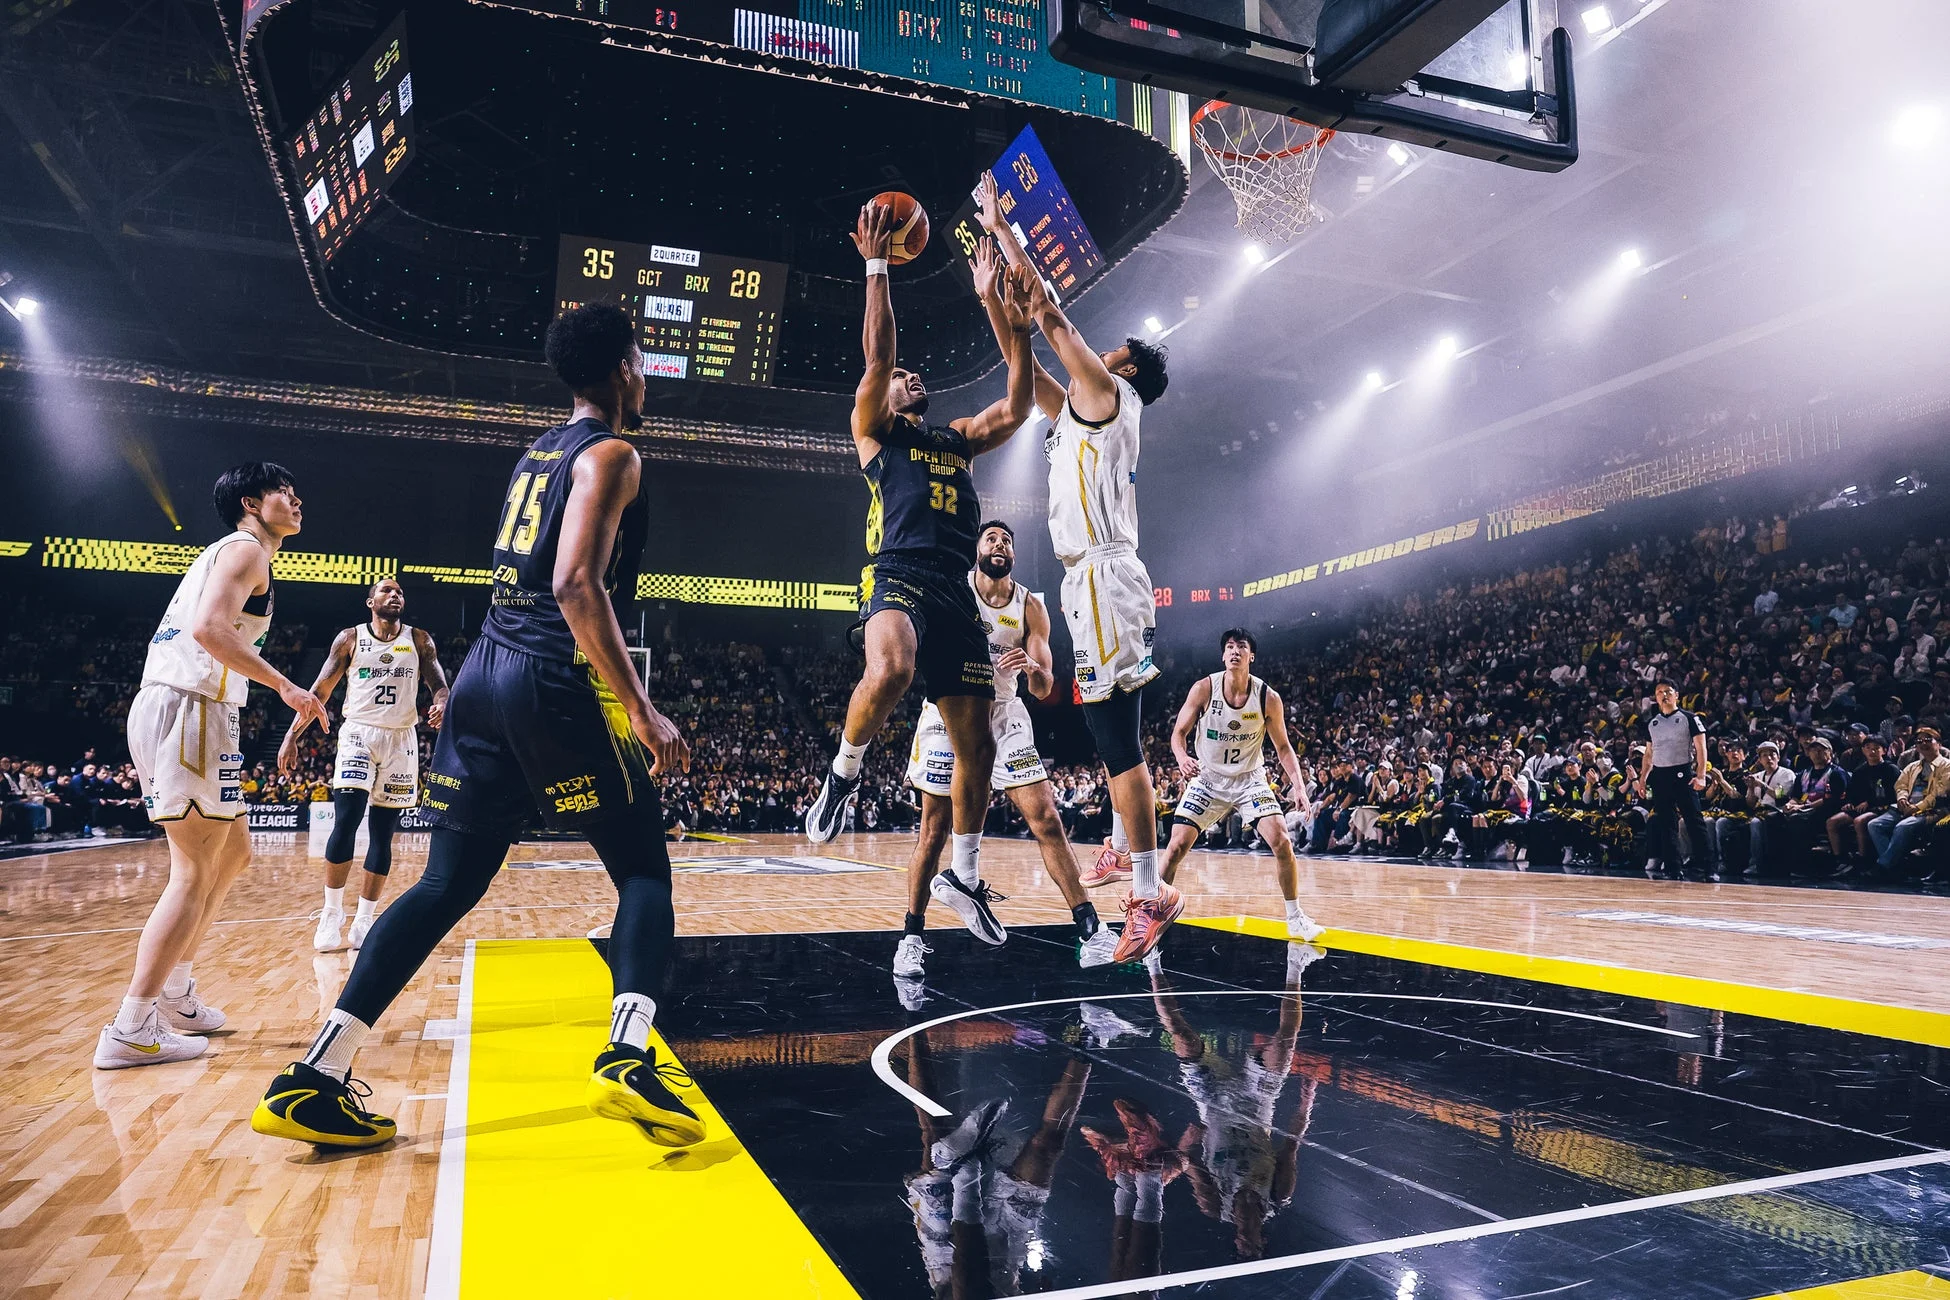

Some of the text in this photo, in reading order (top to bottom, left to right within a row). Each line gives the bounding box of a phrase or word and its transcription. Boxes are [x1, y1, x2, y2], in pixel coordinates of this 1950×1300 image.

[582, 248, 616, 280] 35
[637, 269, 663, 287] GCT
[685, 274, 710, 293] BRX
[729, 269, 761, 300] 28
[910, 448, 938, 463] OPEN
[930, 464, 956, 476] GROUP
[929, 481, 958, 515] 32
[494, 472, 550, 556] 15
[1242, 518, 1480, 598] CRANE THUNDERS
[402, 565, 462, 576] GUNMA
[1154, 587, 1173, 607] 28
[1191, 589, 1211, 603] BRX
[1000, 617, 1017, 627] MANI
[371, 667, 414, 679] 栃木銀行
[375, 685, 397, 705] 25
[1219, 732, 1257, 742] 栃木銀行
[1223, 748, 1240, 764] 12
[428, 772, 461, 790] 毛新聞社
[253, 804, 298, 812] りそなグループ
[555, 790, 599, 813] SEMS
[248, 814, 298, 827] .LEAGUE
